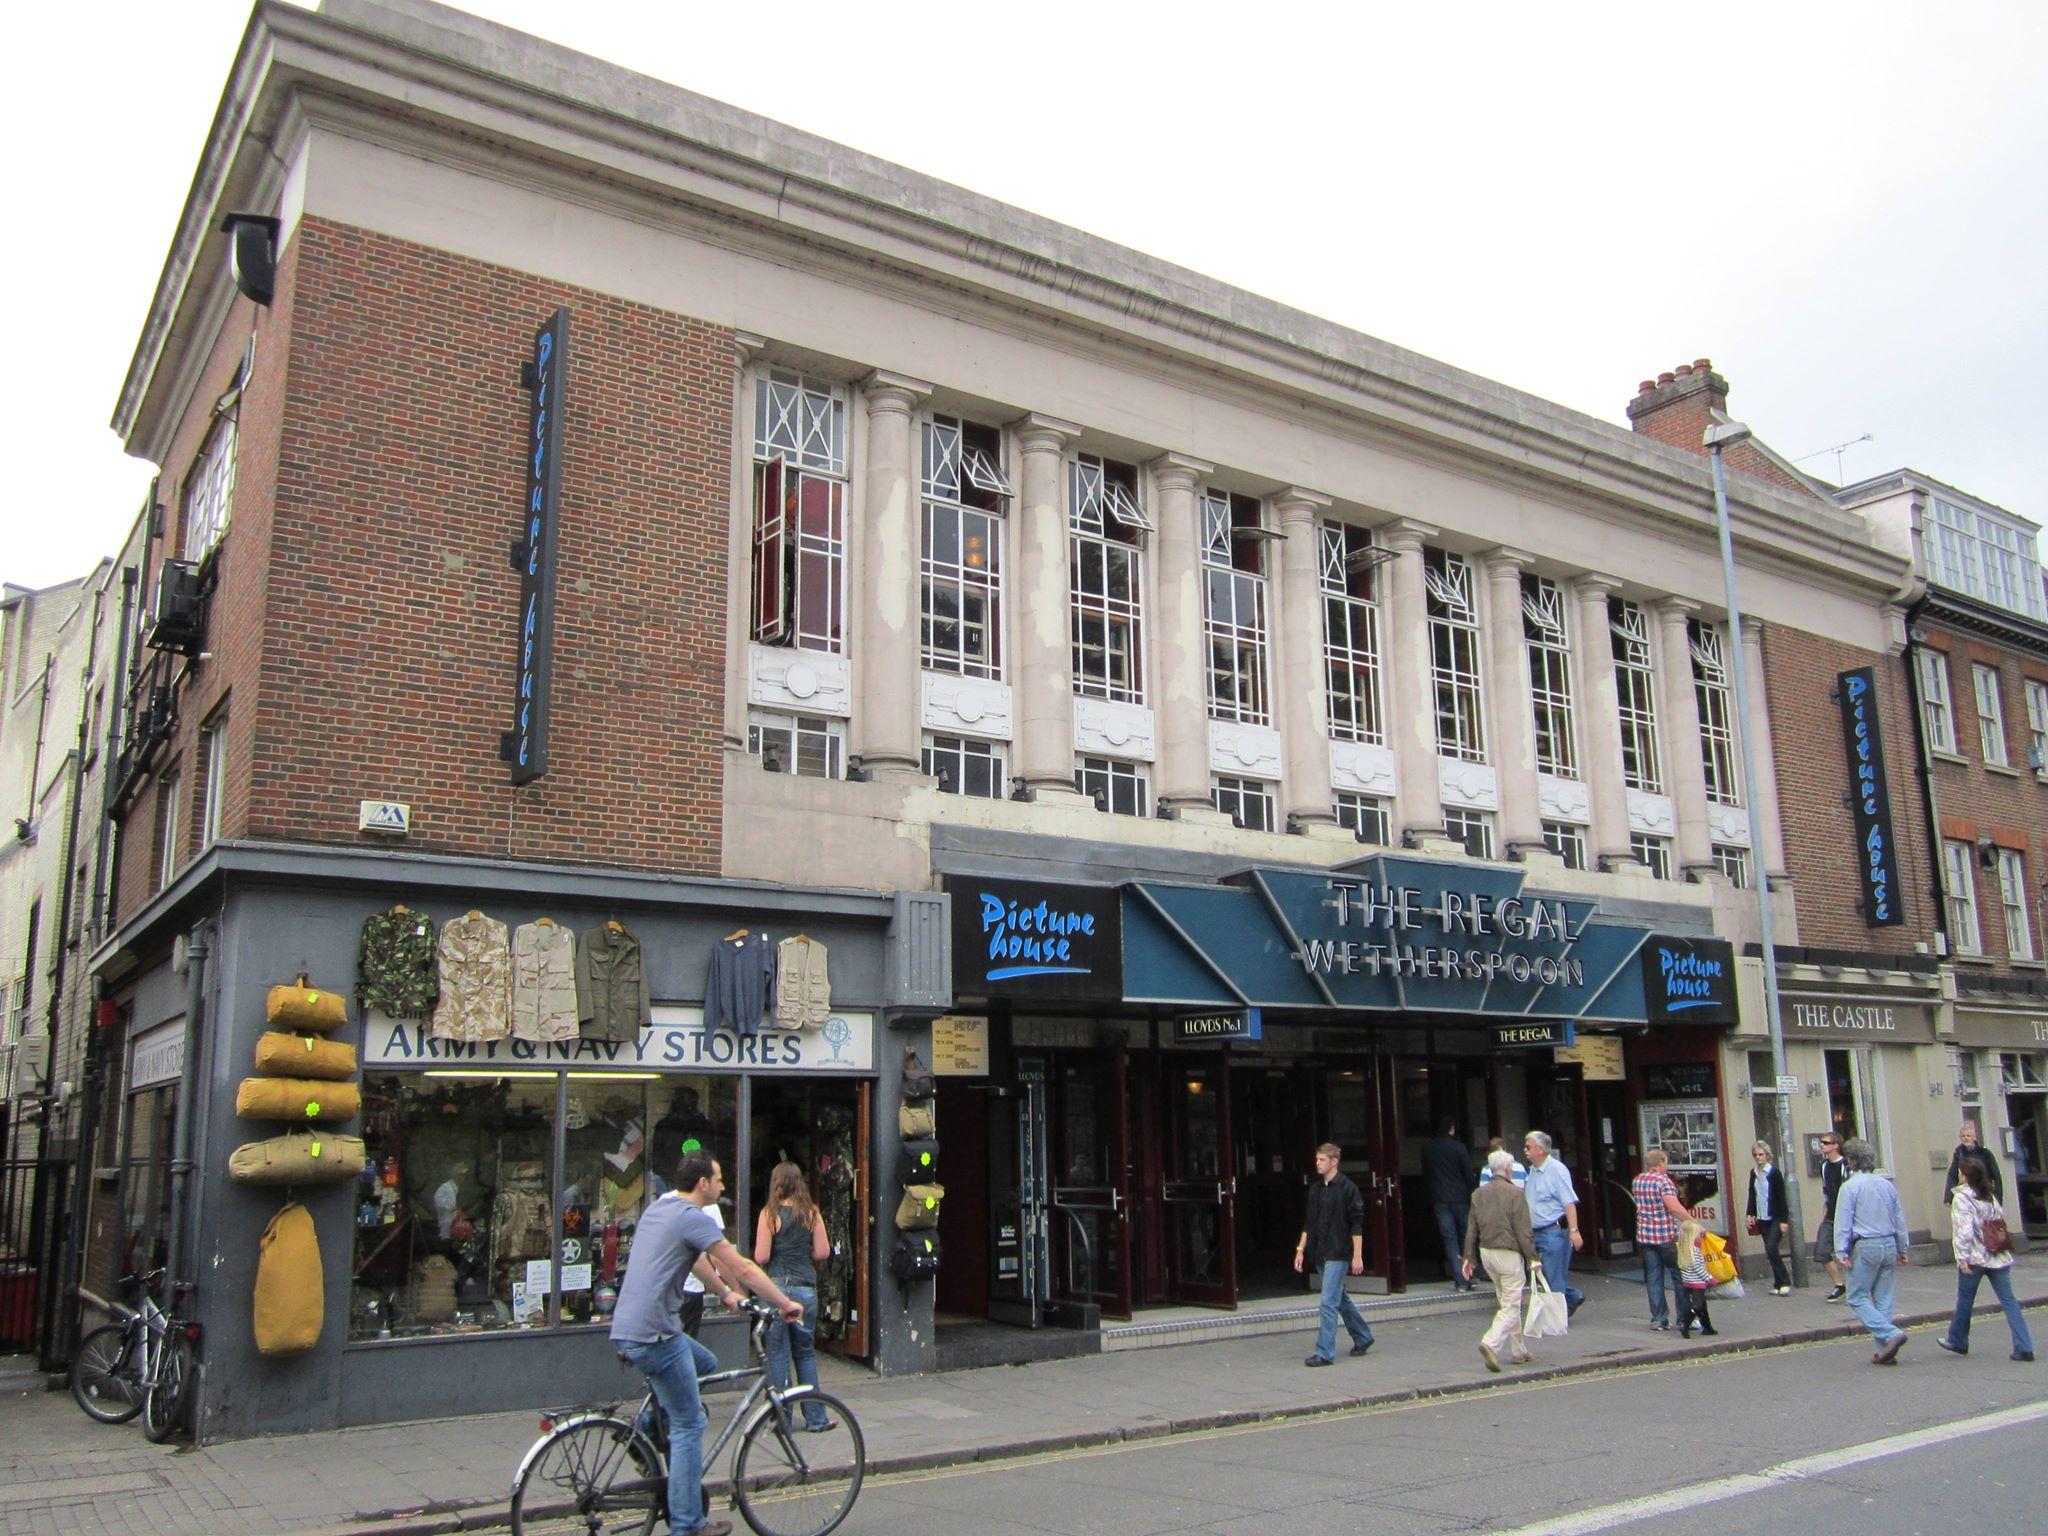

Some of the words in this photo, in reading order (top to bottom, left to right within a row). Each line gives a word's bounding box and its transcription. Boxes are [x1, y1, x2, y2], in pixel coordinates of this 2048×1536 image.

[528, 332, 553, 575] Picture
[519, 592, 536, 766] house
[1845, 677, 1877, 815] Picture
[1867, 823, 1889, 920] house
[980, 892, 1095, 936] Picture
[1328, 880, 1422, 930] THE
[1441, 890, 1580, 943] REGAL
[989, 922, 1071, 962] house
[1303, 939, 1583, 988] WETHERSPOON
[1658, 948, 1722, 978] Picture
[1666, 969, 1710, 997] house
[1185, 1018, 1222, 1034] LLOYDS
[1499, 1030, 1517, 1042] THE
[1519, 1028, 1554, 1041] REGAL
[1793, 1003, 1830, 1028] THE
[1832, 1005, 1896, 1030] CASTLE
[662, 1030, 801, 1066] STORES
